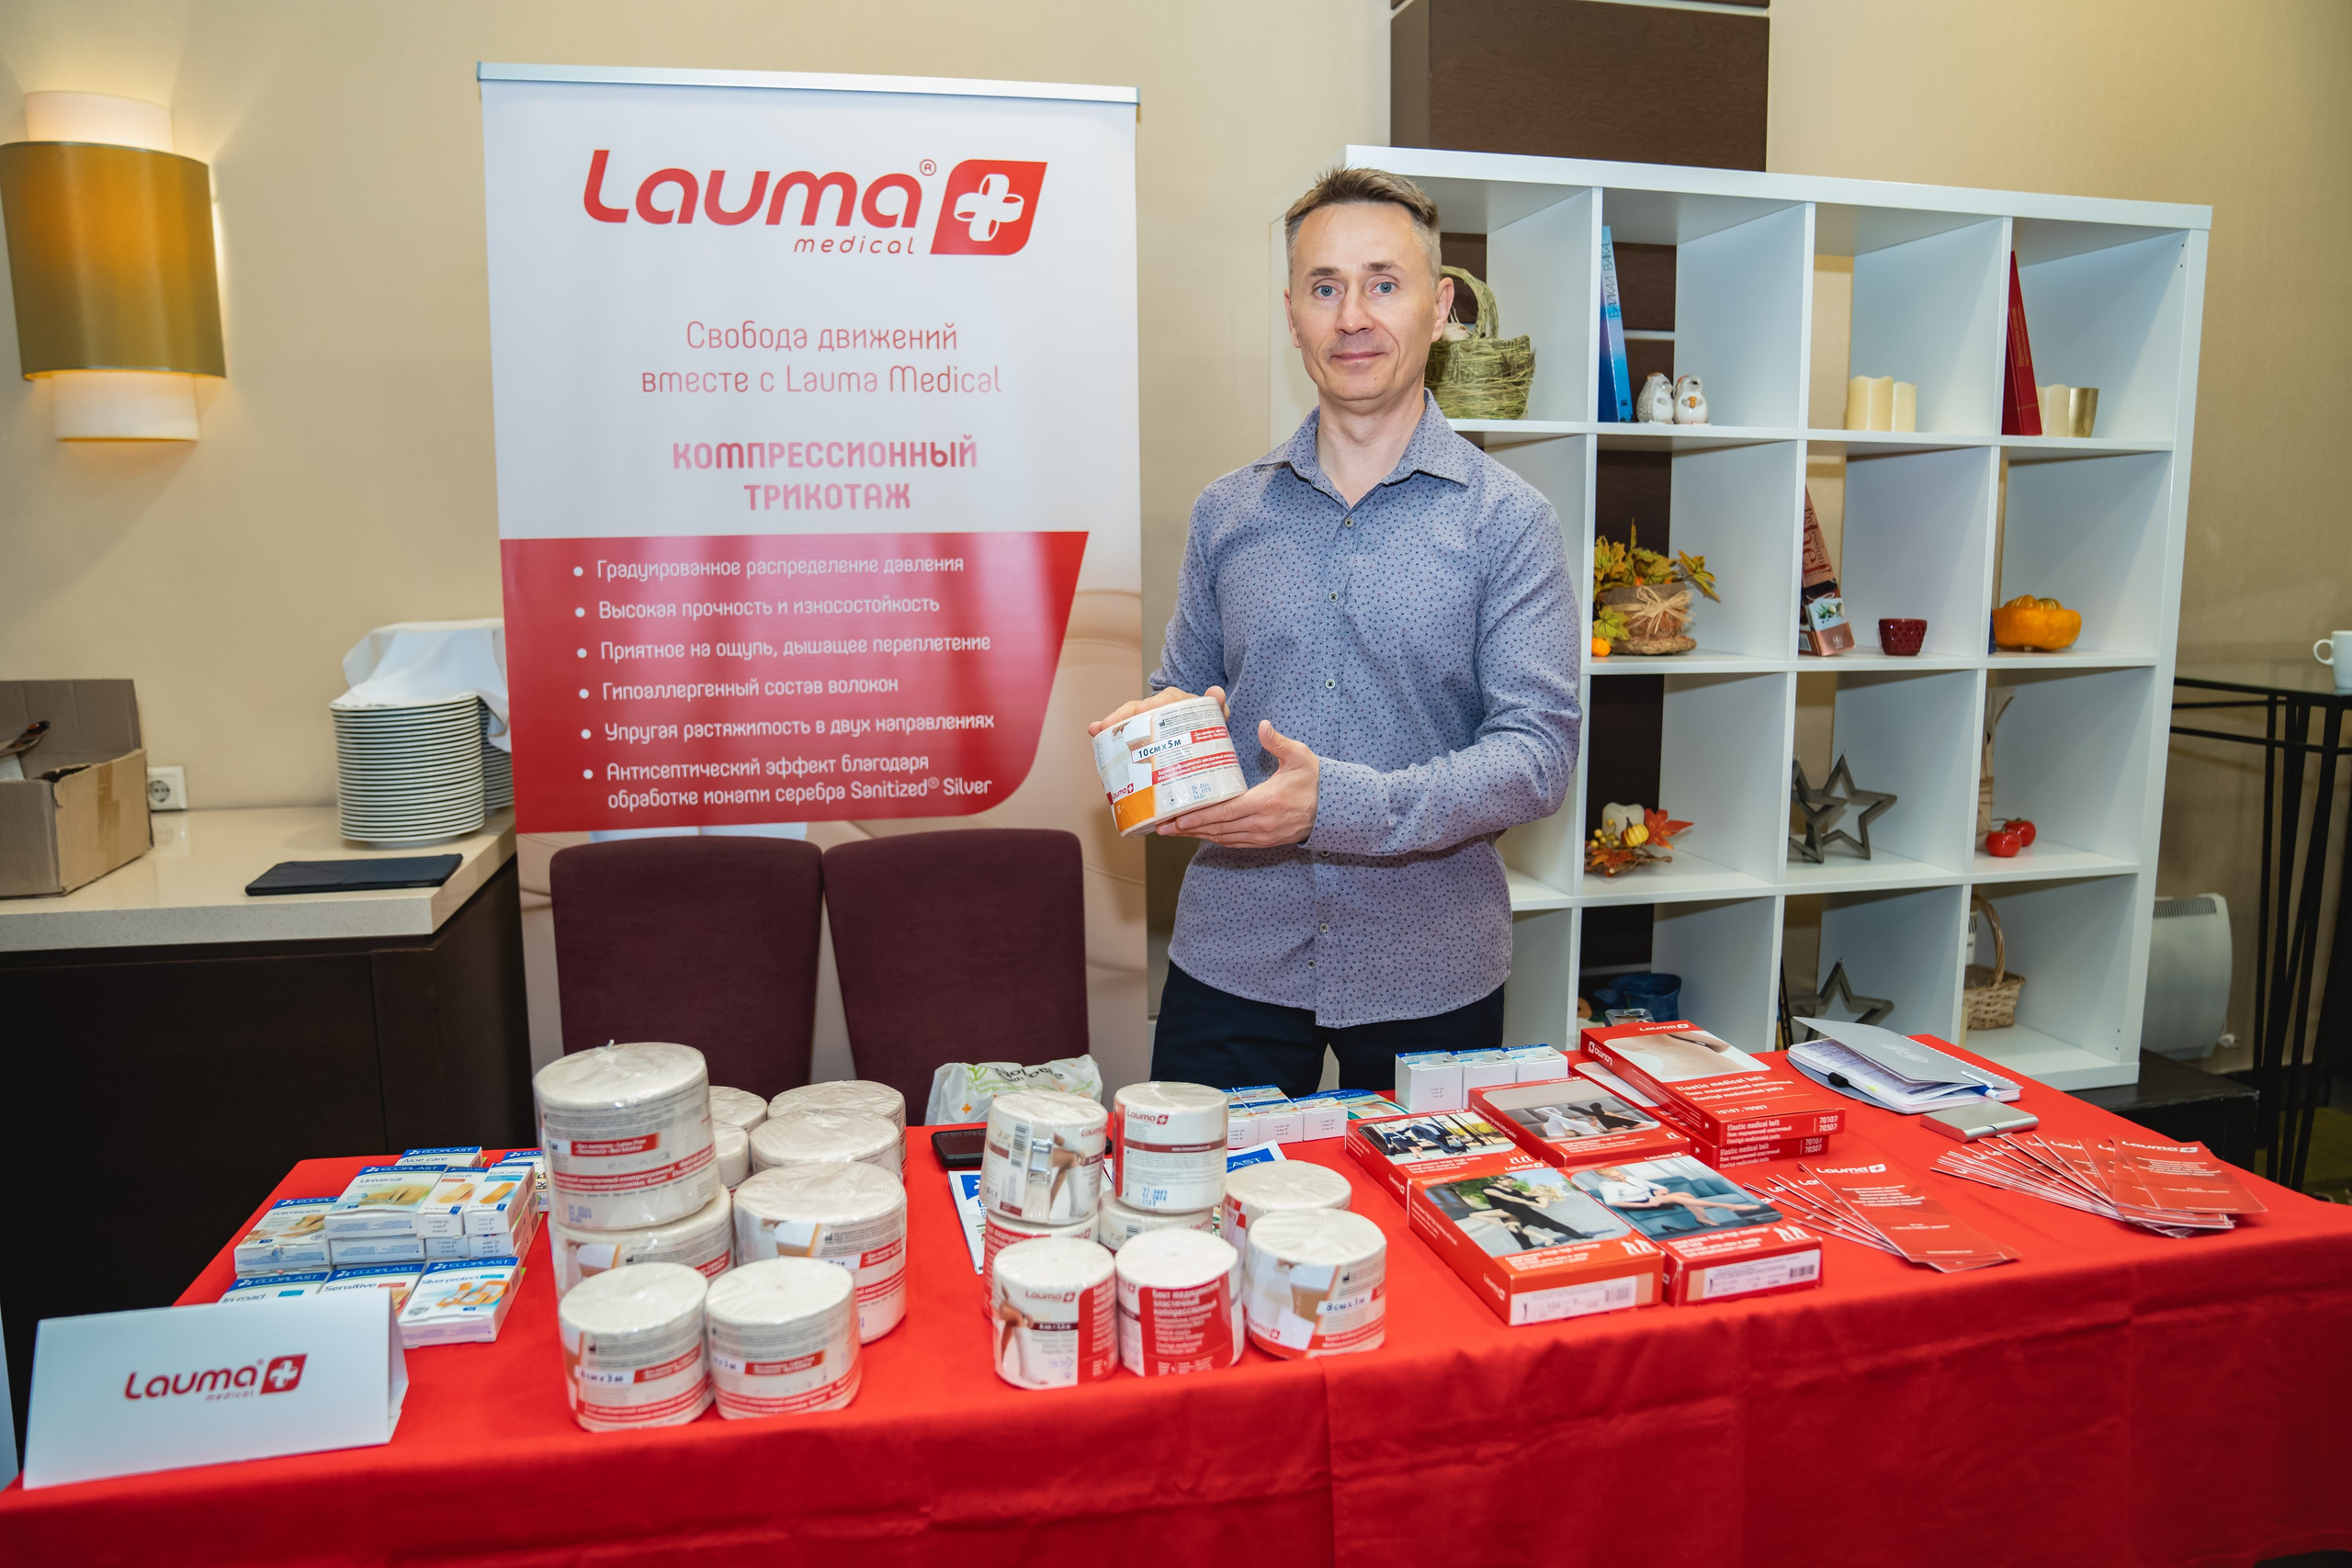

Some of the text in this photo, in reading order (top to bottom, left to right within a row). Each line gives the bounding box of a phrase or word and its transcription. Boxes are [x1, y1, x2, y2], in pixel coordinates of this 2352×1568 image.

[794, 236, 914, 254] medical
[687, 321, 957, 352] Свобода движений
[642, 366, 1002, 393] вместе с Lauma Medical
[673, 434, 978, 469] КОМПРЕССИОННЫЙ
[743, 483, 911, 511] ТРИКОТАЖ
[597, 558, 965, 582] Градуированное распределение давления
[599, 595, 940, 621] Высокая прочность и износостойкость
[600, 636, 991, 664] Приятное на ощупь, дышащее переплетение
[602, 678, 899, 702] Гипоаллергенный состав волокон
[605, 715, 995, 745] Упругая растяжимость в двух направлениях
[1137, 748, 1149, 759] 10
[1149, 744, 1160, 755] см
[1168, 739, 1174, 749] 5
[1174, 739, 1182, 747] м
[606, 754, 930, 781] Антисептический эффект благодаря
[607, 787, 698, 812] обработке
[703, 787, 770, 805] ионами
[775, 783, 845, 806] серебра
[943, 777, 993, 796] Silver
[1594, 1044, 1613, 1066] Lauma
[1675, 1075, 1766, 1091] Elastic medical belt
[1127, 1110, 1156, 1121] Lauma
[1818, 1115, 1838, 1124] 70107
[1726, 1119, 1781, 1131] Elastic medical belt
[1818, 1123, 1838, 1132] 70307
[1804, 1136, 1823, 1145] 70107
[2121, 1140, 2177, 1153] Lauma
[1720, 1147, 1738, 1156] Elastic
[1739, 1145, 1758, 1155] medical
[1804, 1145, 1823, 1153] 70307
[1505, 1163, 1534, 1171] Lauma
[352, 1265, 413, 1275] ECOPLAST
[448, 1259, 510, 1269] ECOPLAST
[254, 1274, 317, 1284] ECOPLAST
[325, 1281, 378, 1292] Sensitive
[1152, 1288, 1170, 1298] Бинт
[1025, 1291, 1062, 1301] Lauma
[1153, 1296, 1200, 1307] эластичный
[1153, 1297, 1217, 1317] компрессионный
[1327, 1303, 1332, 1311] 8
[205, 1389, 254, 1402] medical
